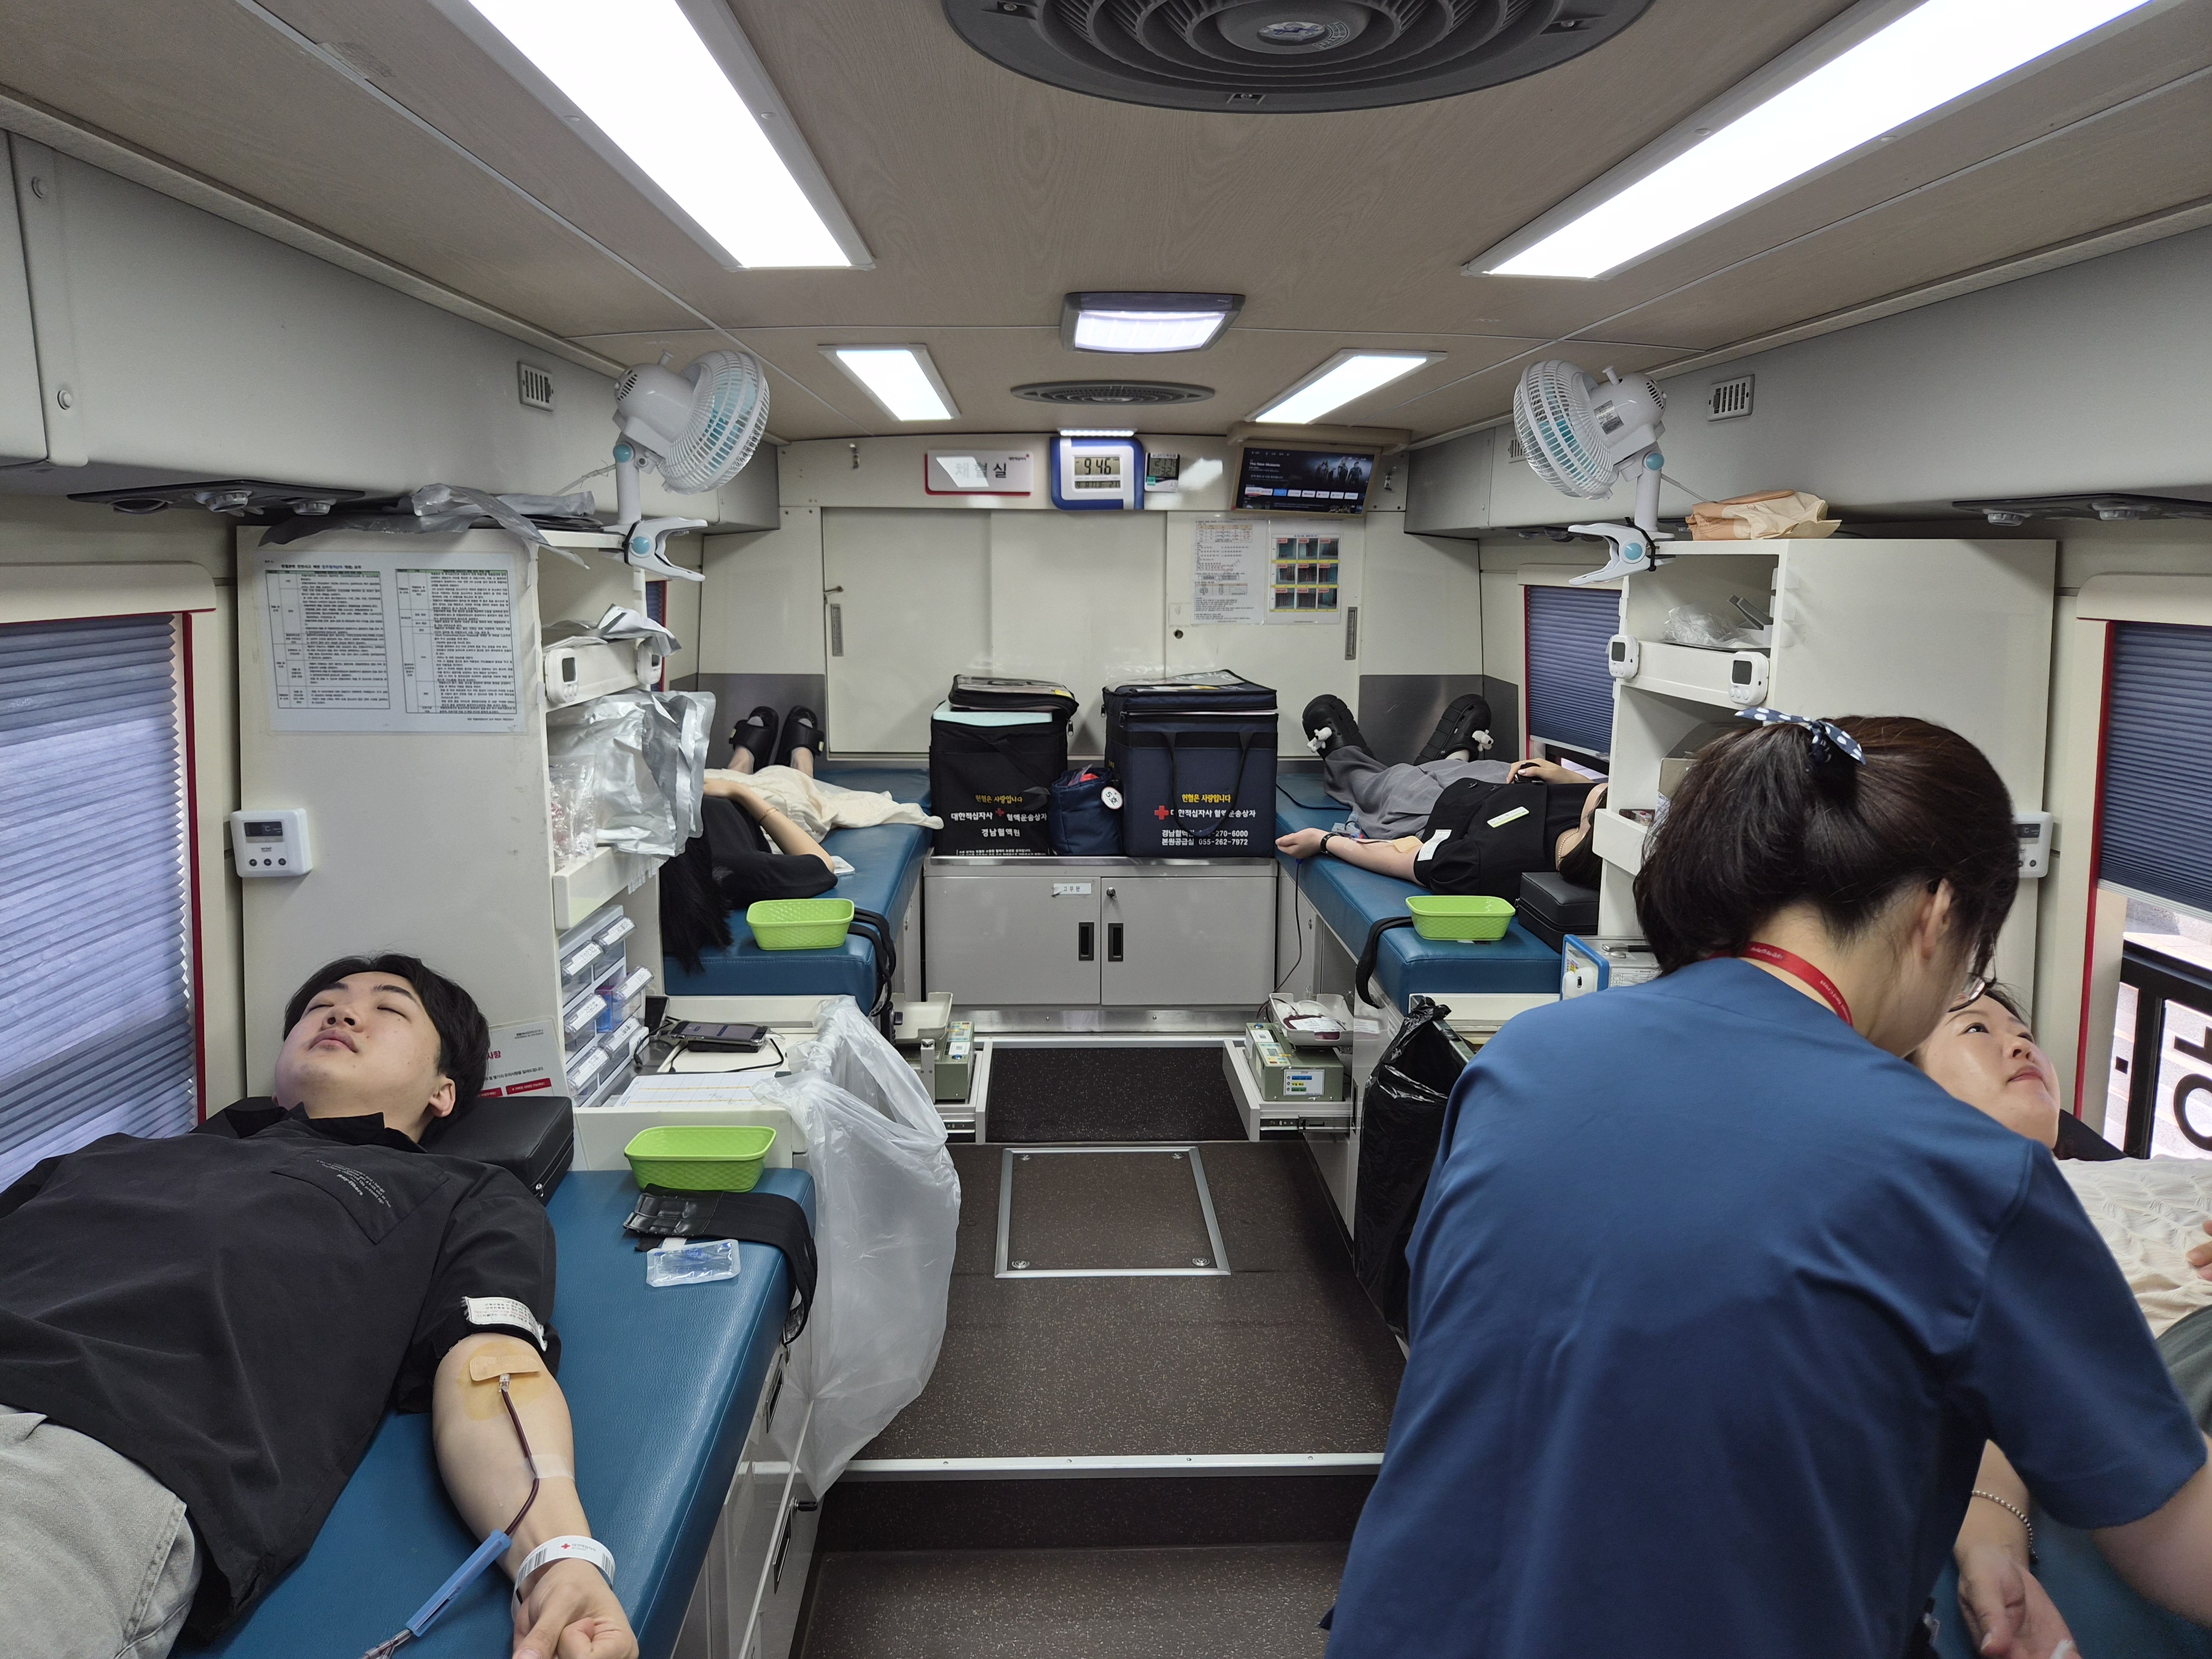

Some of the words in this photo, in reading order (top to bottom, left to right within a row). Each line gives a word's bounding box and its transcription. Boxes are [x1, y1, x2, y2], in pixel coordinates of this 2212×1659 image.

[975, 794, 993, 803] 헌혈은
[994, 795, 1023, 804] 사랑입니다
[1181, 794, 1200, 803] 헌혈은
[1201, 794, 1231, 803] 사랑입니다
[951, 812, 993, 821] 대한적십자사
[1006, 813, 1047, 822] 혈액운송상자
[982, 828, 1020, 837] 경남혈액원
